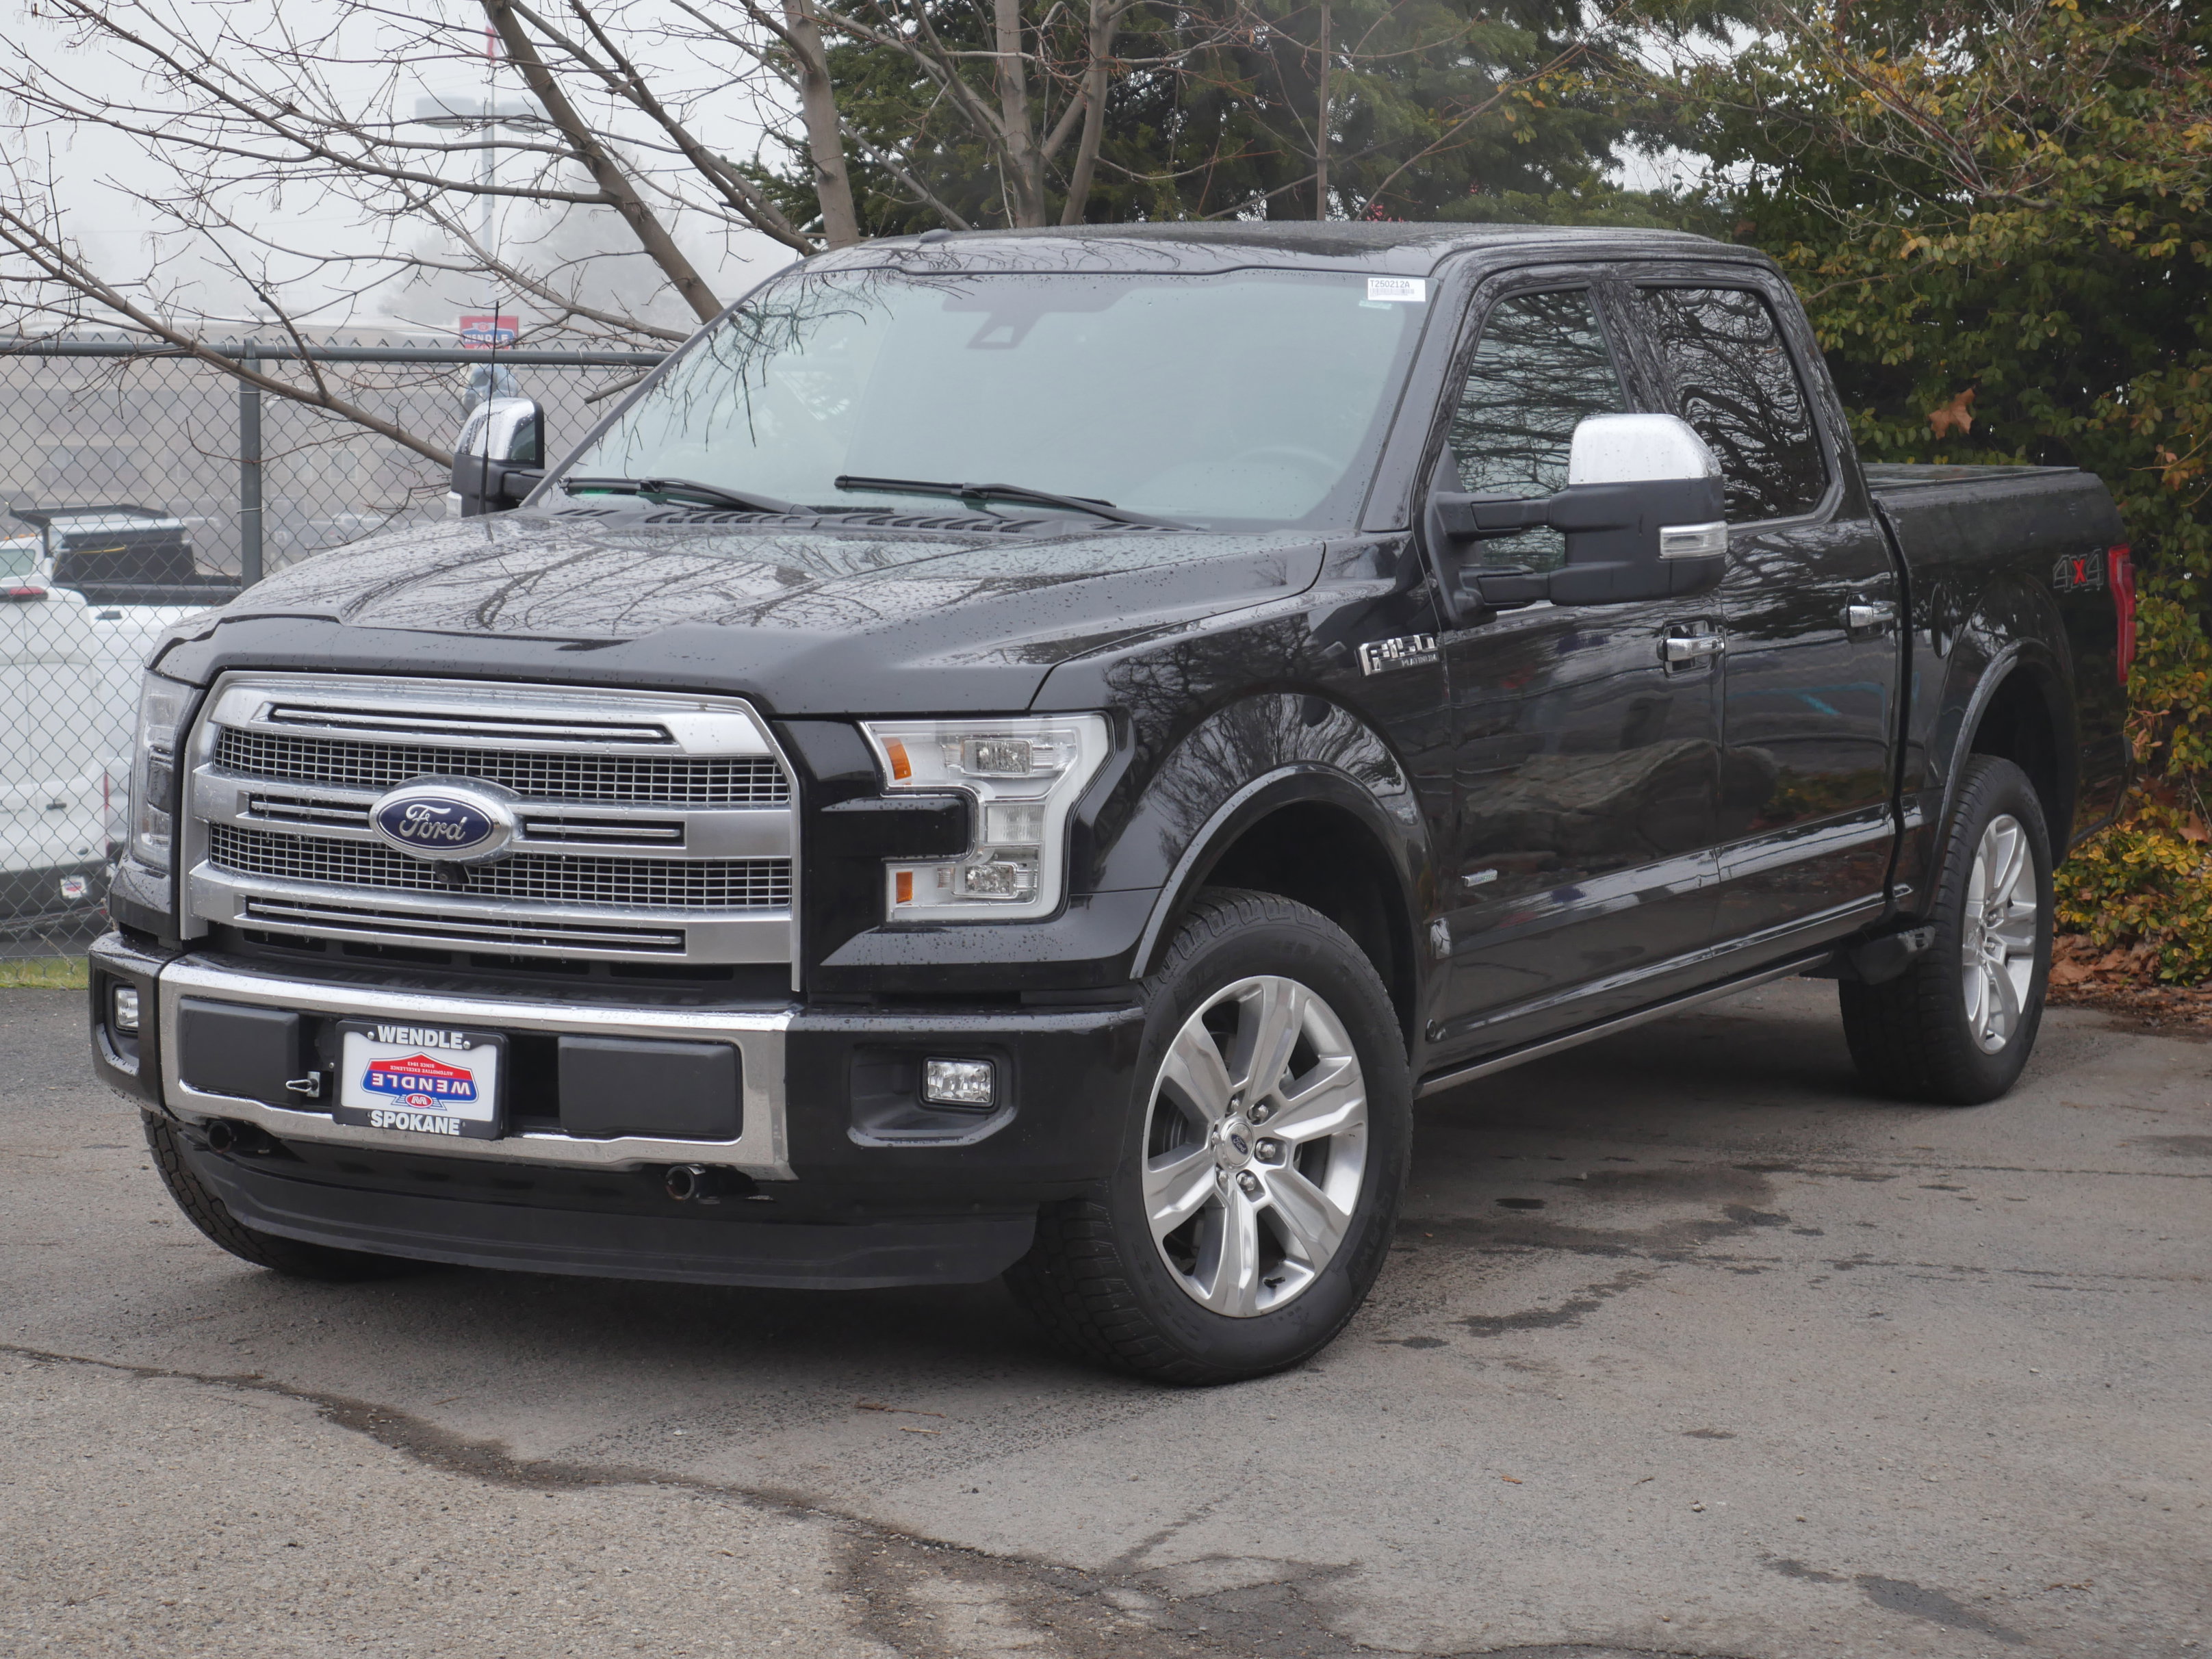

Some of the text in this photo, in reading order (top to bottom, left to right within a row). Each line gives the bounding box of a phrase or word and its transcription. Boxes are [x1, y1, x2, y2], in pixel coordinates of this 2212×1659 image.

[1369, 280, 1410, 288] T250212A
[1402, 654, 1437, 667] PLATINUM
[399, 803, 467, 840] Ford
[377, 1025, 463, 1049] WENDLE
[372, 1072, 471, 1095] WENDLE
[370, 1110, 461, 1135] SPOKANE
[1232, 1136, 1247, 1153] Ford
